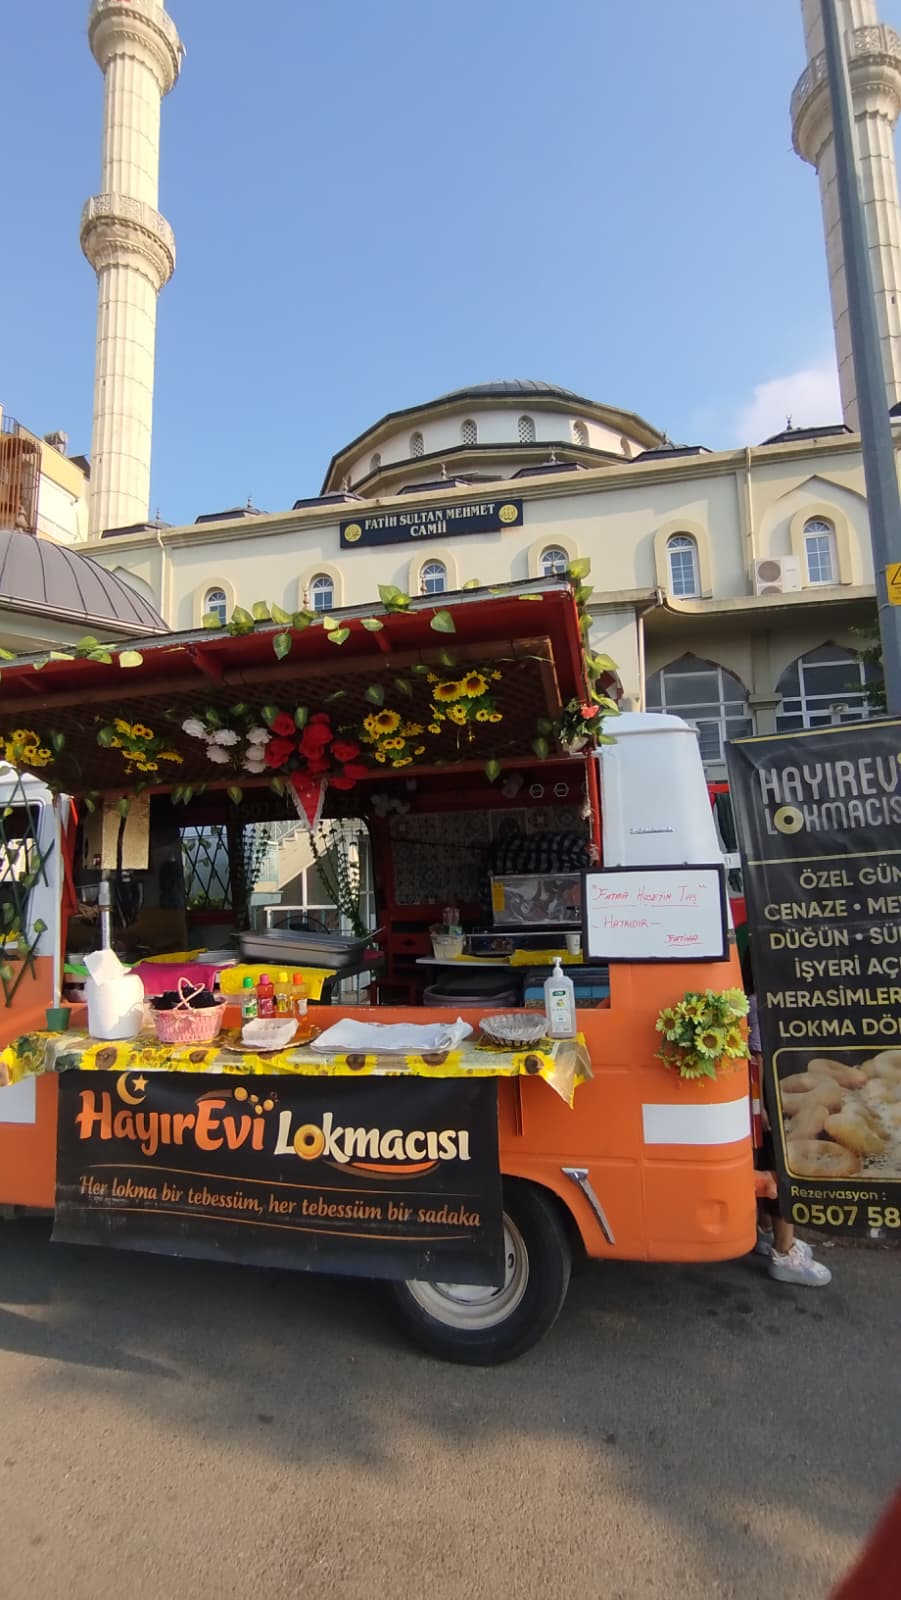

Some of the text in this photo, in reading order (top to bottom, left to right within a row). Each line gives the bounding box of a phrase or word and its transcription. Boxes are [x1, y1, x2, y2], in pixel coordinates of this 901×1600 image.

[365, 504, 495, 530] FATİH SULTAN MEHMET
[410, 520, 447, 536] CAMİİ
[800, 868, 854, 889] ÖZEL
[764, 896, 901, 921] CENAZE ME
[769, 923, 901, 950] DÜĞÜN SÜ
[795, 954, 901, 982] İŞYERİ AÇ
[766, 985, 901, 1009] MERASİMLER
[778, 1013, 901, 1038] LOKMA DÖ
[274, 1110, 471, 1163] Lokmacısı
[79, 1175, 481, 1227] Her lokma bir tebessüm, her tebessüm bir sadaka
[791, 1185, 878, 1202] Rezervasyon
[791, 1202, 901, 1228] 0507 58
